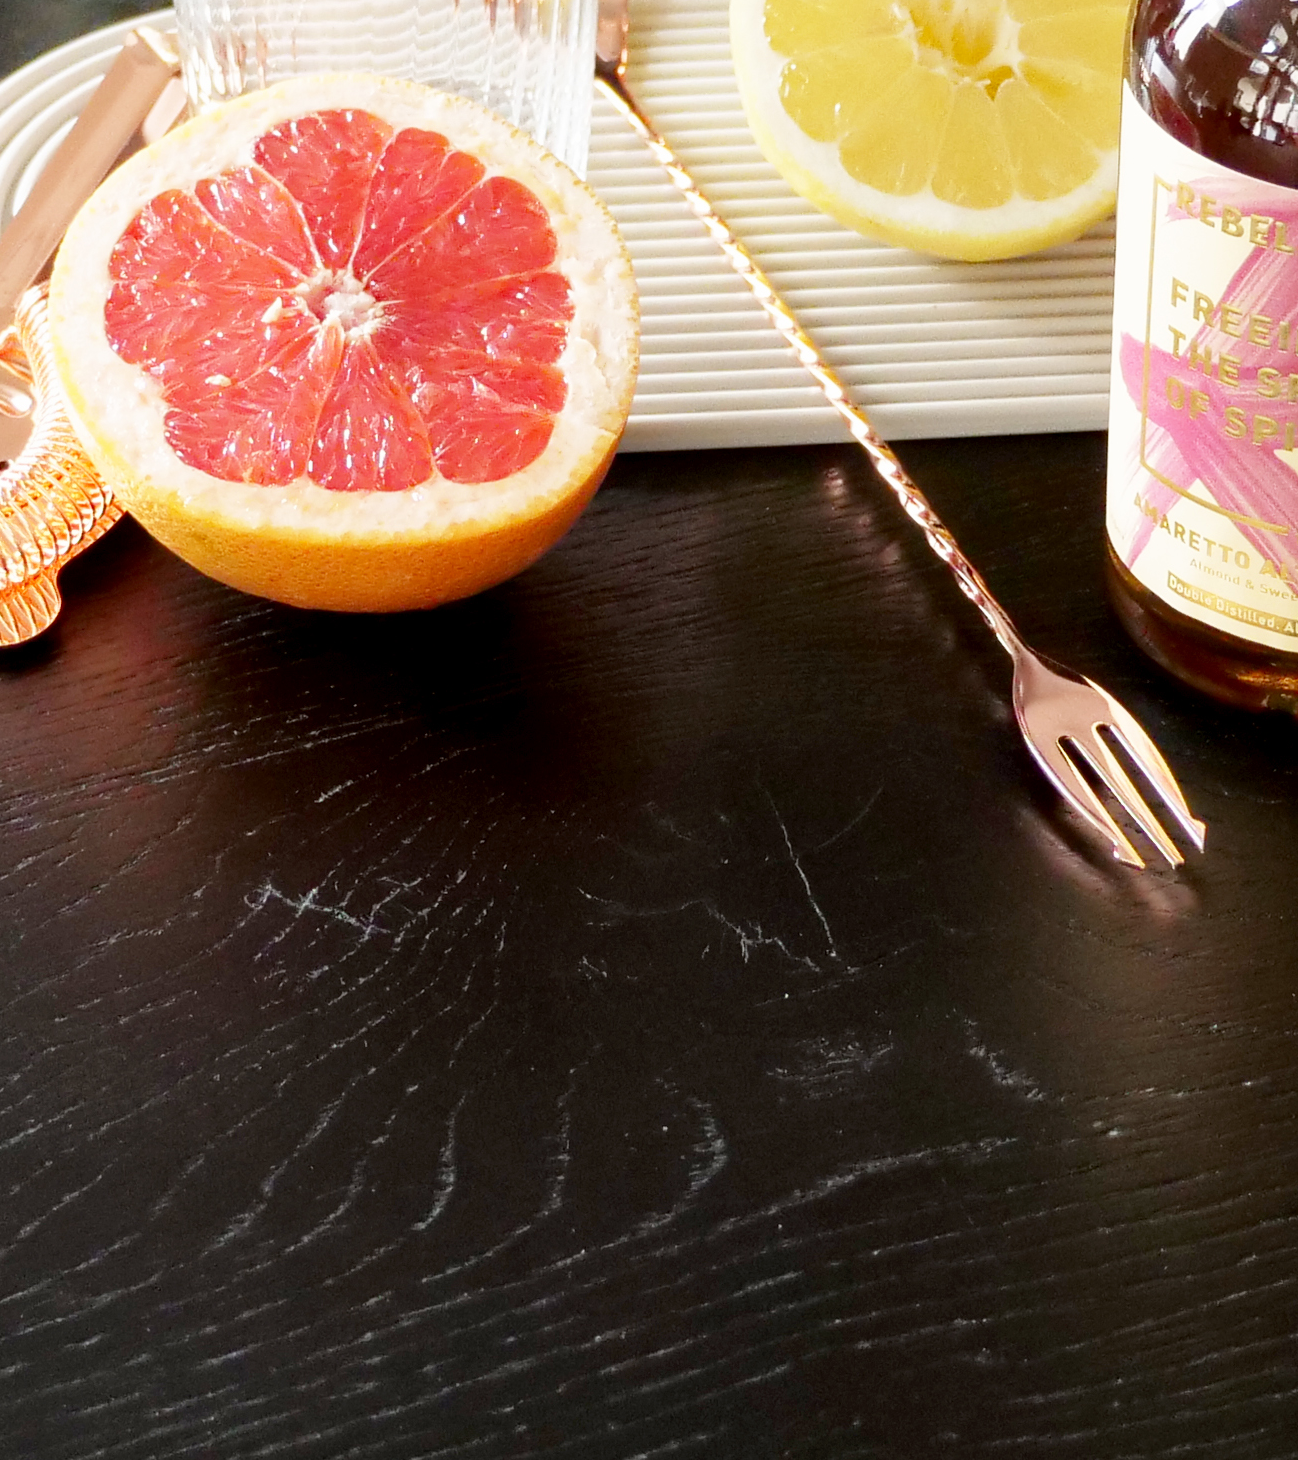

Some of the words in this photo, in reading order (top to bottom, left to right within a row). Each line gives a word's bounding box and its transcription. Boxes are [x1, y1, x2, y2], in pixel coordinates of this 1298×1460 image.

[1168, 325, 1242, 388] THE
[1165, 376, 1210, 420] OF
[1133, 491, 1251, 570] AMARETTO
[1169, 574, 1212, 606] Double
[1216, 598, 1280, 630] Distilled.
[1190, 558, 1240, 586] Almond
[1245, 579, 1255, 590] &
